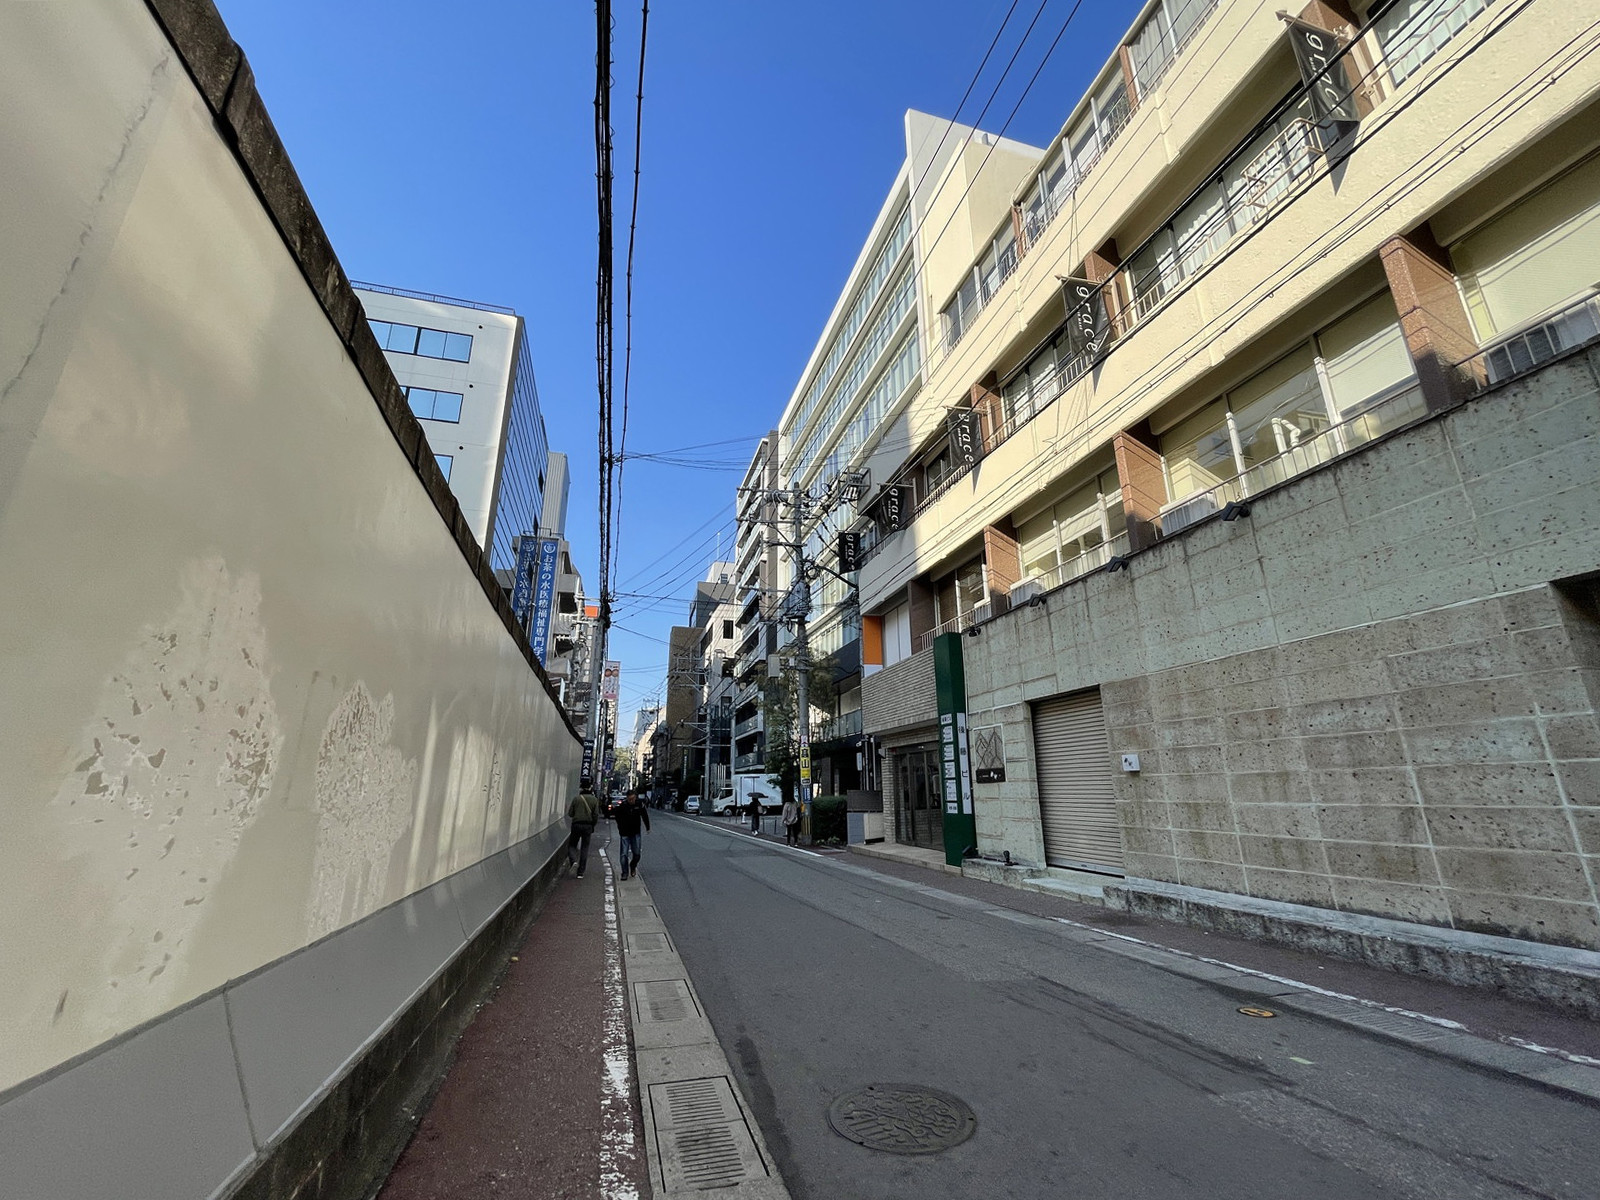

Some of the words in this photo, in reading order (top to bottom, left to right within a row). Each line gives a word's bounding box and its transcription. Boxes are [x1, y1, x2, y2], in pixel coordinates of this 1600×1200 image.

[1076, 286, 1098, 352] grace
[958, 413, 974, 463] grace
[889, 488, 900, 530] grace
[846, 534, 855, 571] grace
